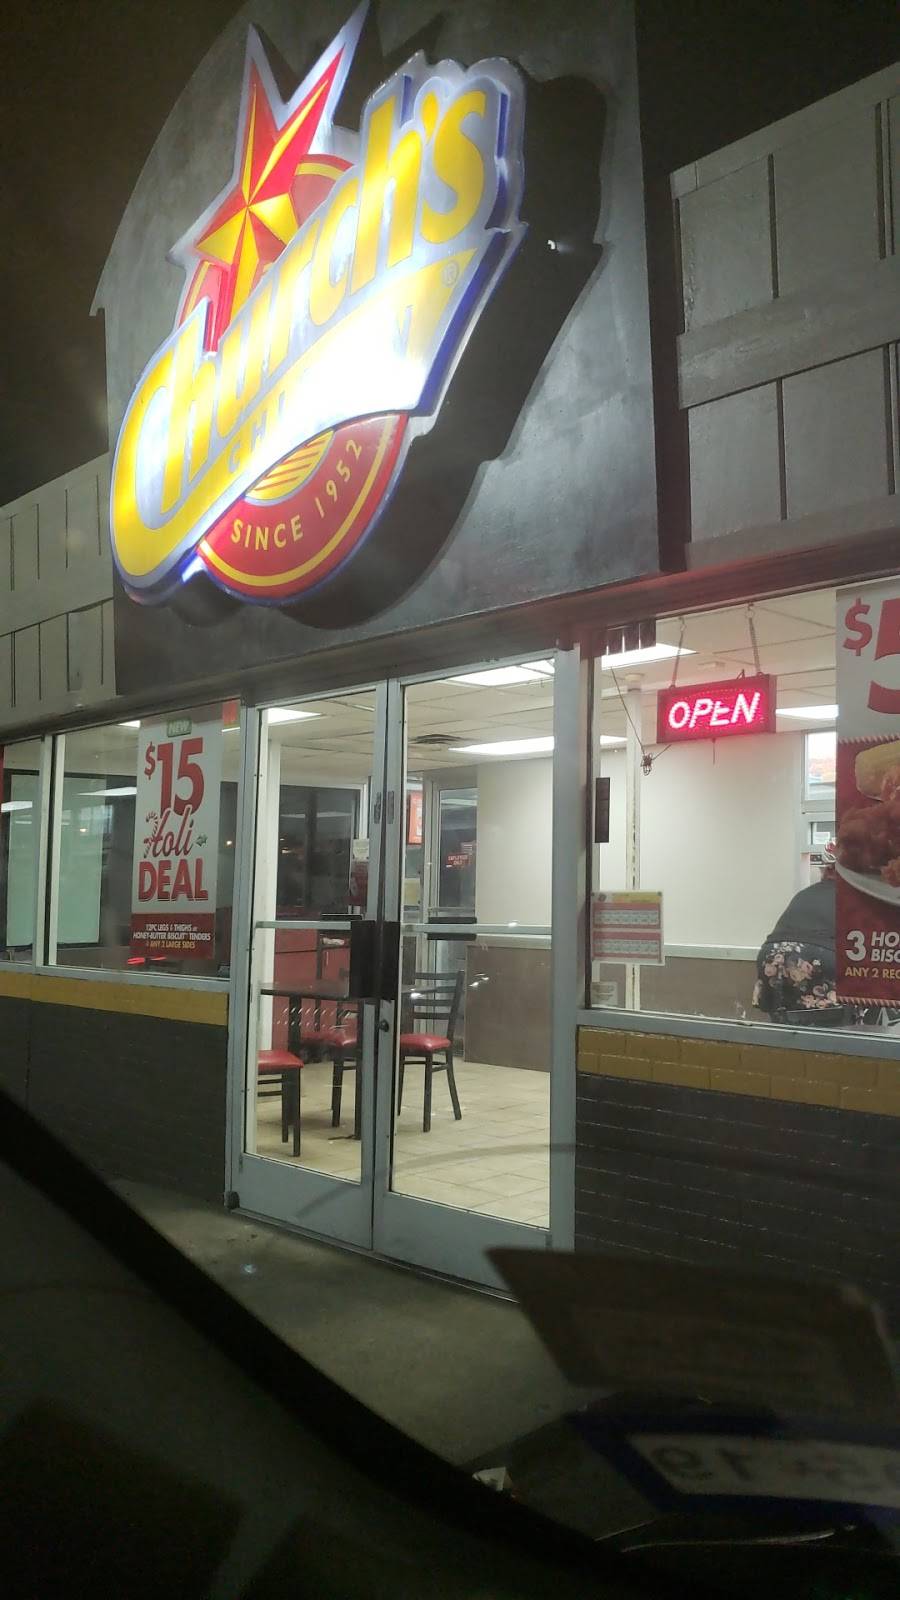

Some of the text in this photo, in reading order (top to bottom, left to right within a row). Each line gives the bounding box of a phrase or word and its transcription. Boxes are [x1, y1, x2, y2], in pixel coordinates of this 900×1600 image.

[112, 88, 486, 577] Church's
[231, 438, 363, 551] SINCE 1952
[668, 691, 761, 730] OPEN
[144, 736, 205, 819] $15
[138, 858, 209, 902] DEAL
[150, 940, 160, 948] ANY
[182, 941, 196, 949] SIDES
[189, 933, 211, 941] TENDERS
[845, 930, 866, 961] 3
[845, 966, 869, 977] ANY
[871, 967, 879, 978] 2
